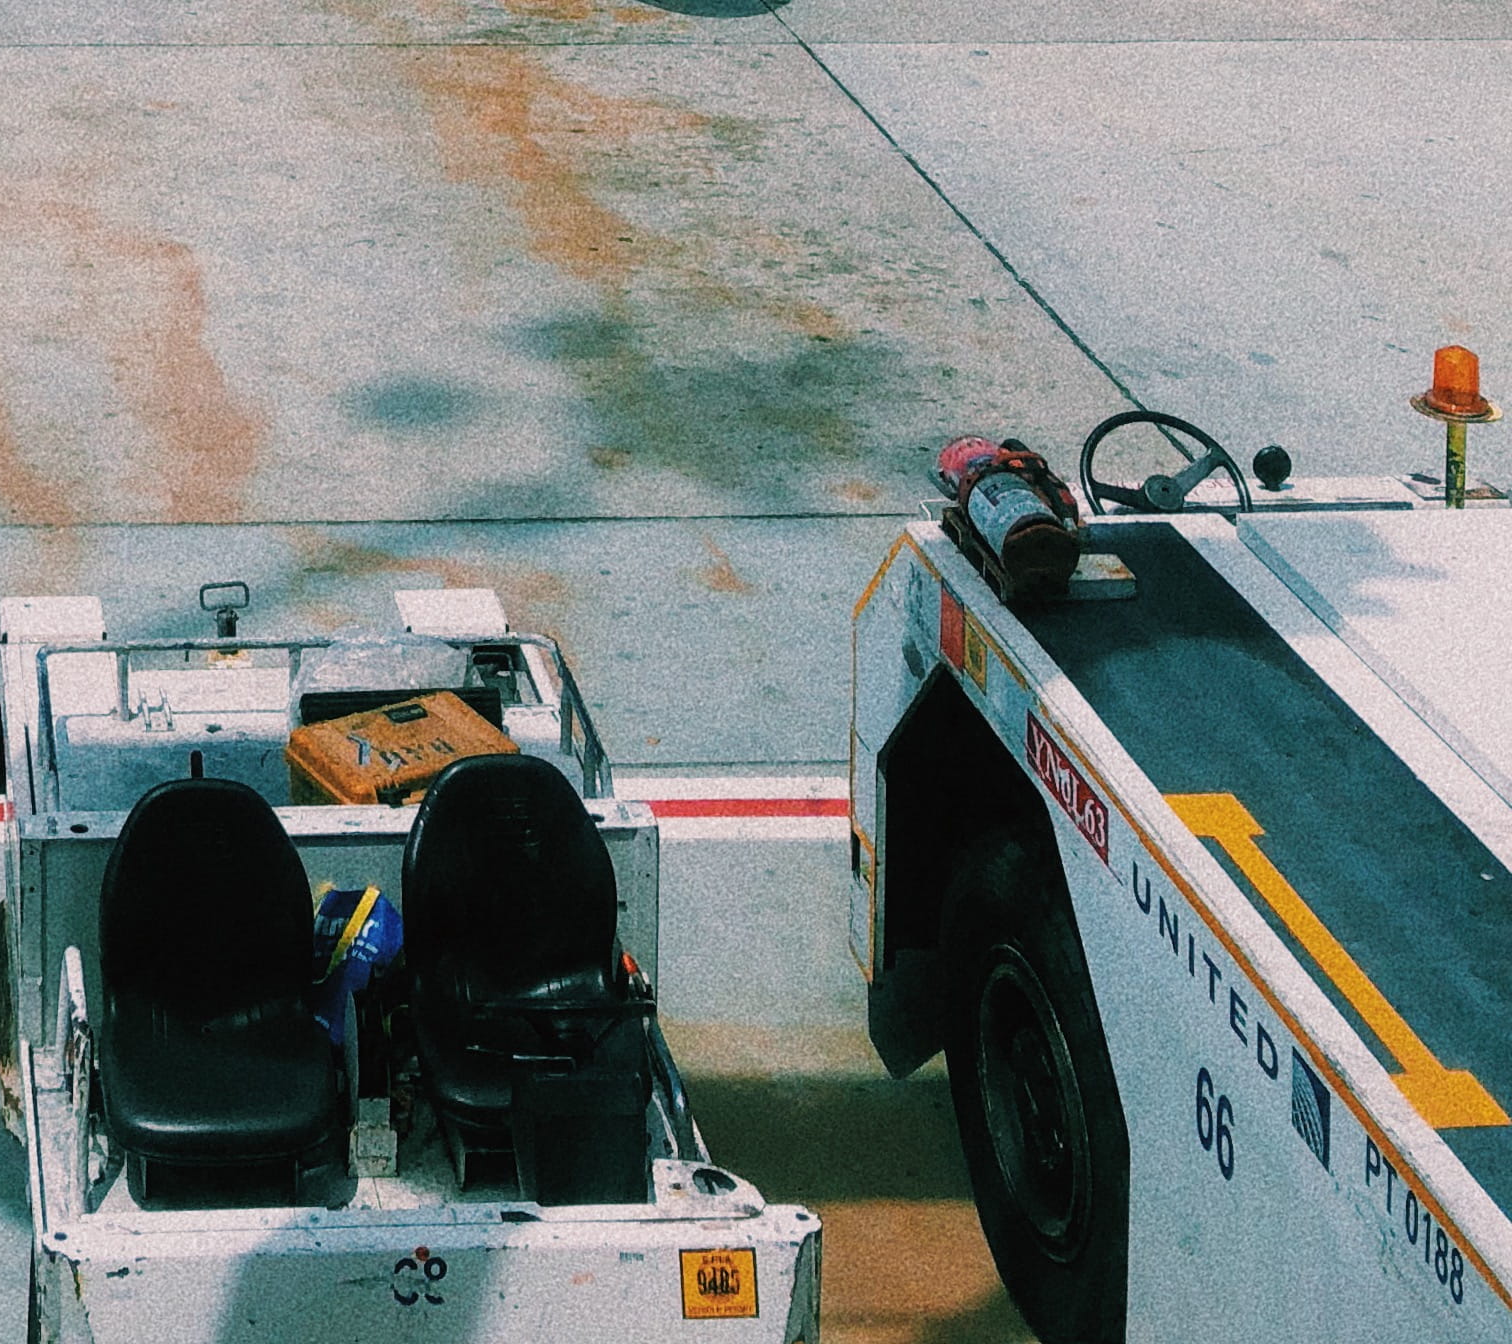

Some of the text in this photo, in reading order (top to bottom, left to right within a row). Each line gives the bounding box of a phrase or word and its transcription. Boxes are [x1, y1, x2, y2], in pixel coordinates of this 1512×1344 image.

[1132, 860, 1279, 1081] UNITED
[1196, 1066, 1235, 1181] 66
[1365, 1134, 1464, 1305] PT 0188
